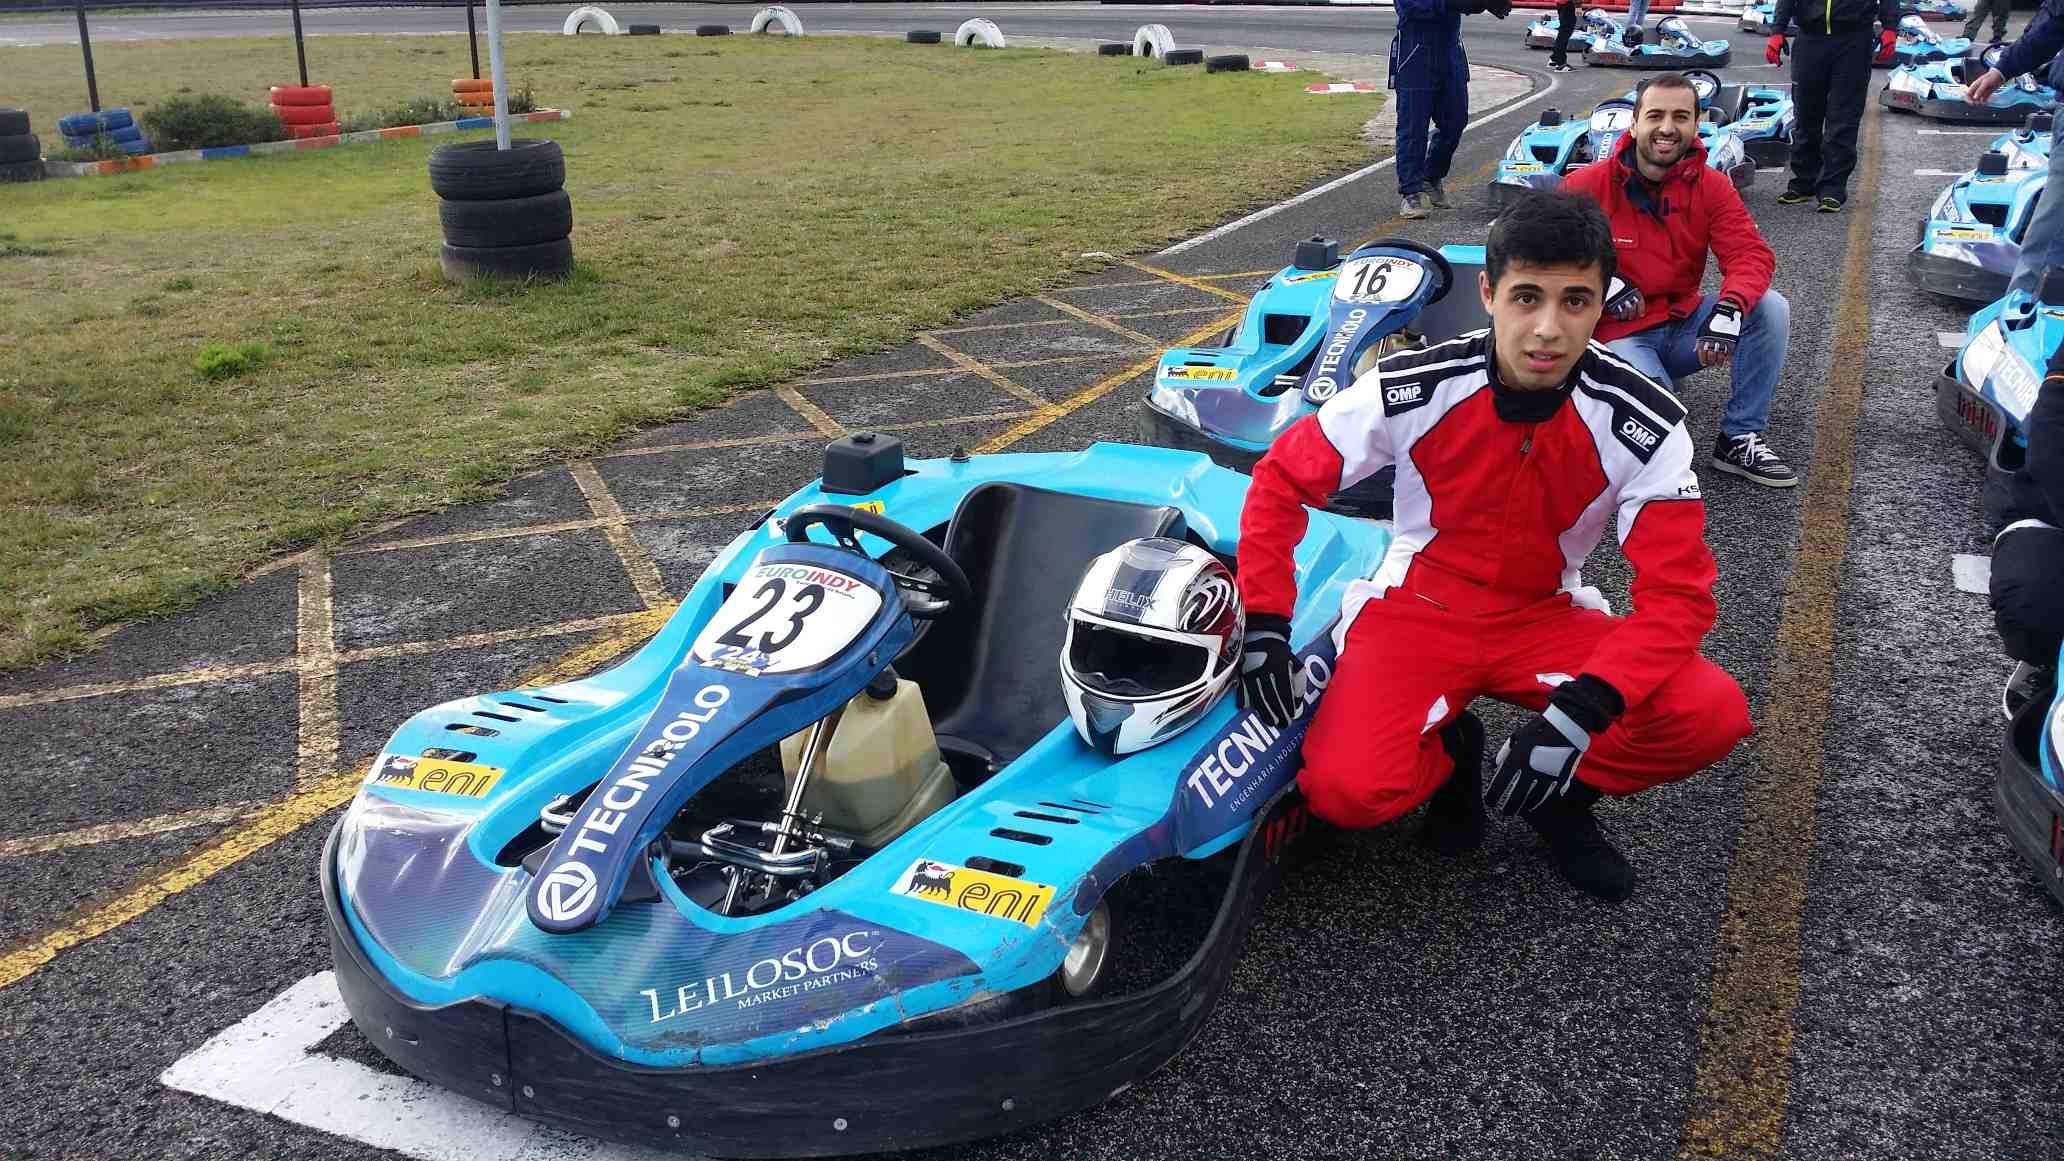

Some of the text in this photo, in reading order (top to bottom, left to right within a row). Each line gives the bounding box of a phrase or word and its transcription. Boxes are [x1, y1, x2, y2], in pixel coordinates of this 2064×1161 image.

[1607, 112, 1617, 128] 7
[1352, 263, 1392, 295] 16
[1386, 385, 1422, 403] OMP
[1622, 420, 1657, 447] OMP
[754, 566, 861, 592] EUROINDY
[714, 577, 826, 655] 23
[1104, 587, 1154, 609] HELIX
[1187, 654, 1331, 809] TECNIO
[419, 767, 497, 797] eni
[567, 684, 731, 857] TECNIROLO
[1230, 763, 1276, 813] ENGENHARIA
[958, 882, 1047, 923] eni
[640, 931, 872, 1024] LEILOSOC
[737, 957, 879, 1011] MARKET PARTNERS
